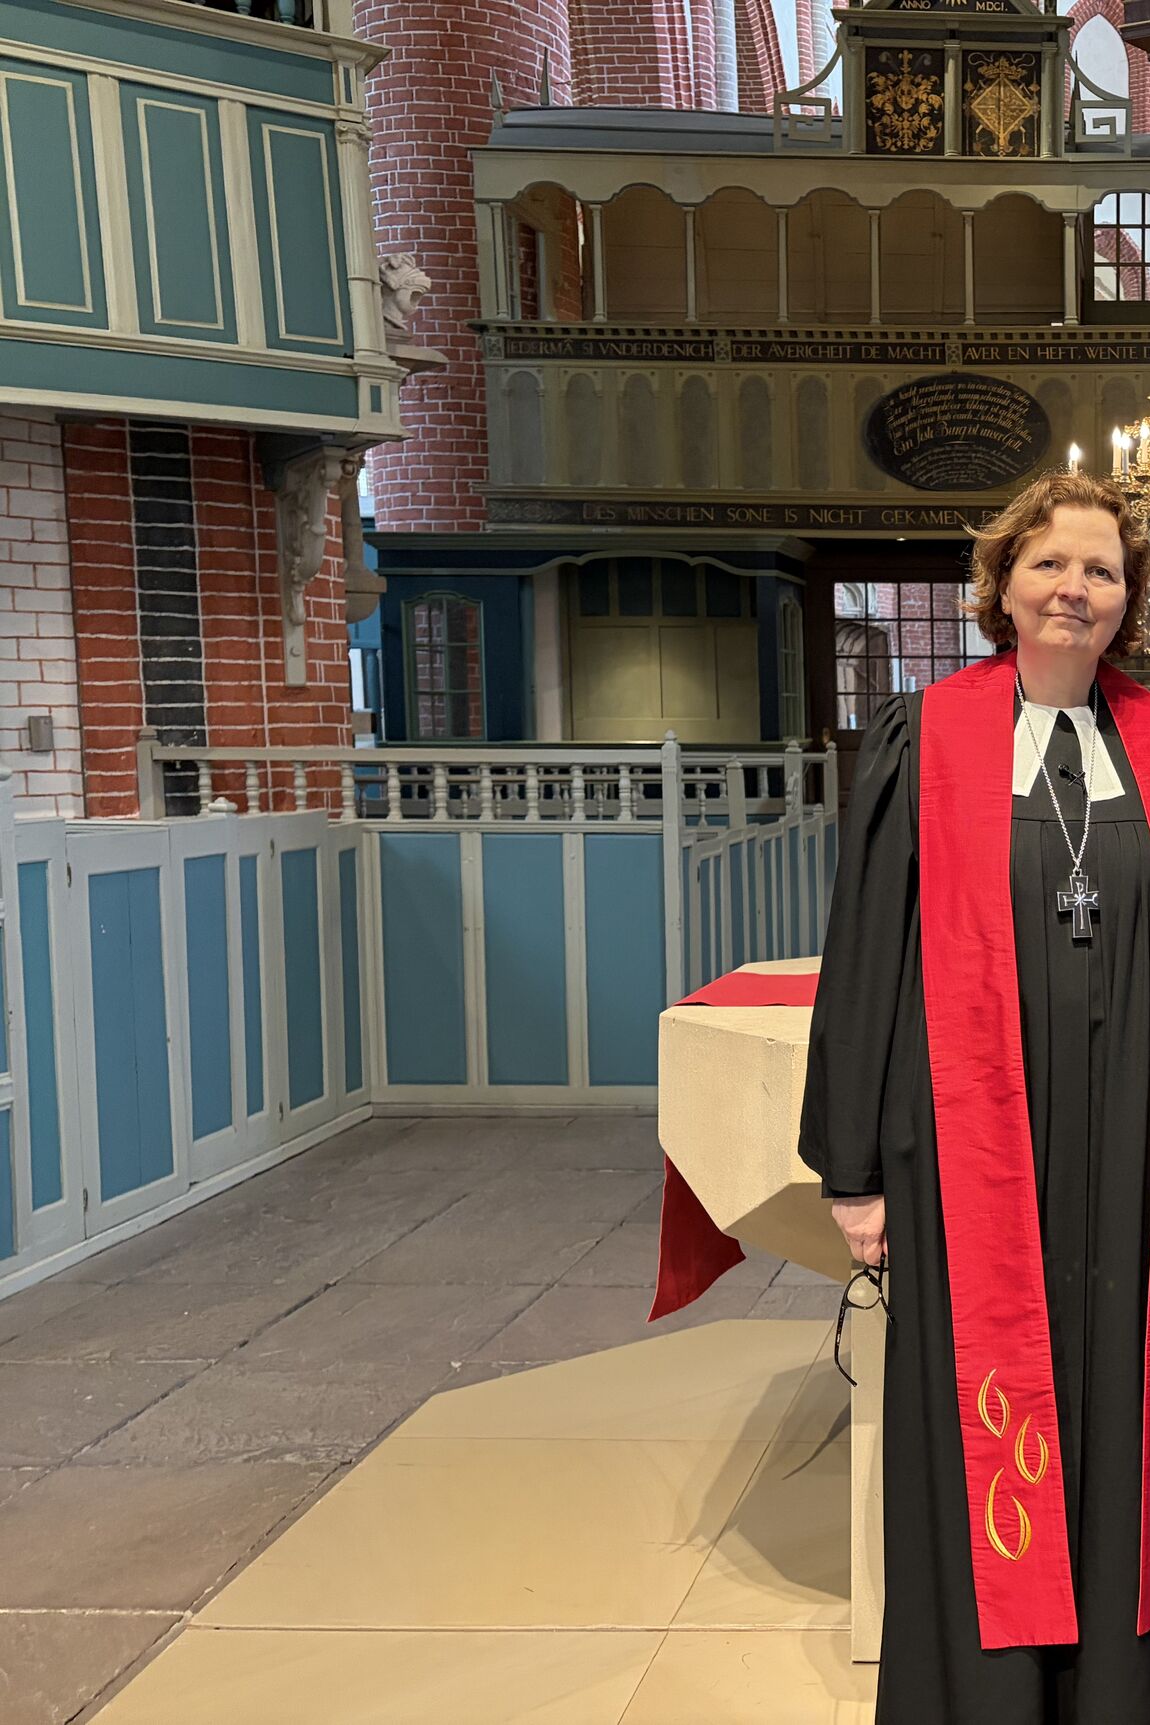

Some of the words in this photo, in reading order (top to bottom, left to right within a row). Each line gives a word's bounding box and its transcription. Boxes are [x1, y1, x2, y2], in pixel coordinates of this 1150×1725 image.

[900, 0, 932, 10] ANNO
[732, 343, 762, 358] DER
[861, 344, 881, 360] DE
[888, 345, 944, 361] MACHT
[964, 346, 1001, 361] AVER
[1008, 346, 1030, 361] EN
[1085, 345, 1138, 360] WENTE
[893, 438, 914, 456] Ein
[627, 505, 715, 522] MINSCHEN
[727, 507, 776, 523] SONE
[785, 507, 798, 524] IS
[809, 507, 868, 525] NICHT
